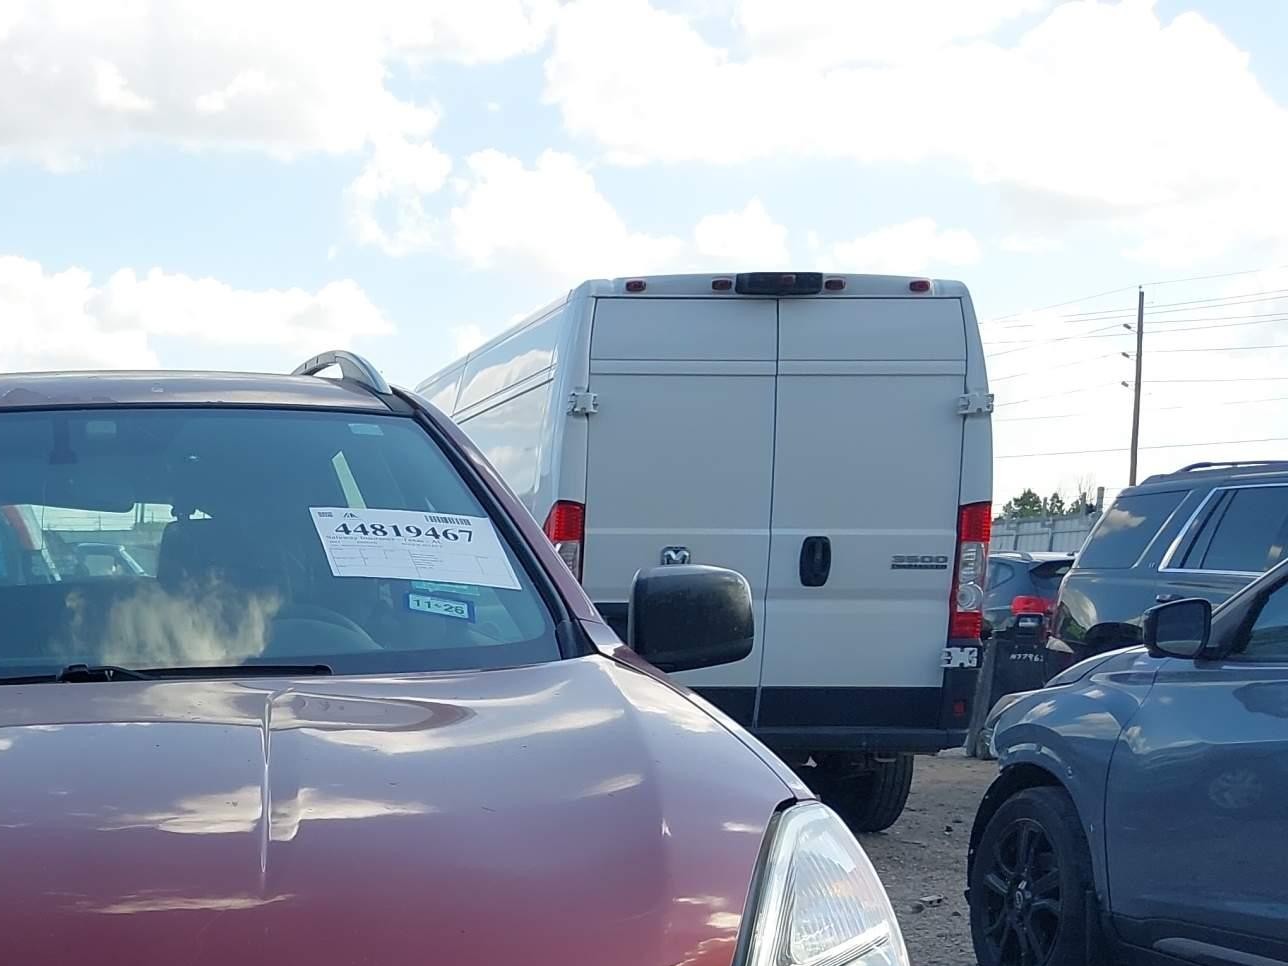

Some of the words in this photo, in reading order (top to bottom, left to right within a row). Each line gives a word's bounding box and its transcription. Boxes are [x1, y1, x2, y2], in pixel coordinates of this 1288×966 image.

[334, 522, 473, 543] 44819467
[891, 555, 949, 564] 3500
[413, 599, 465, 615] 11-26
